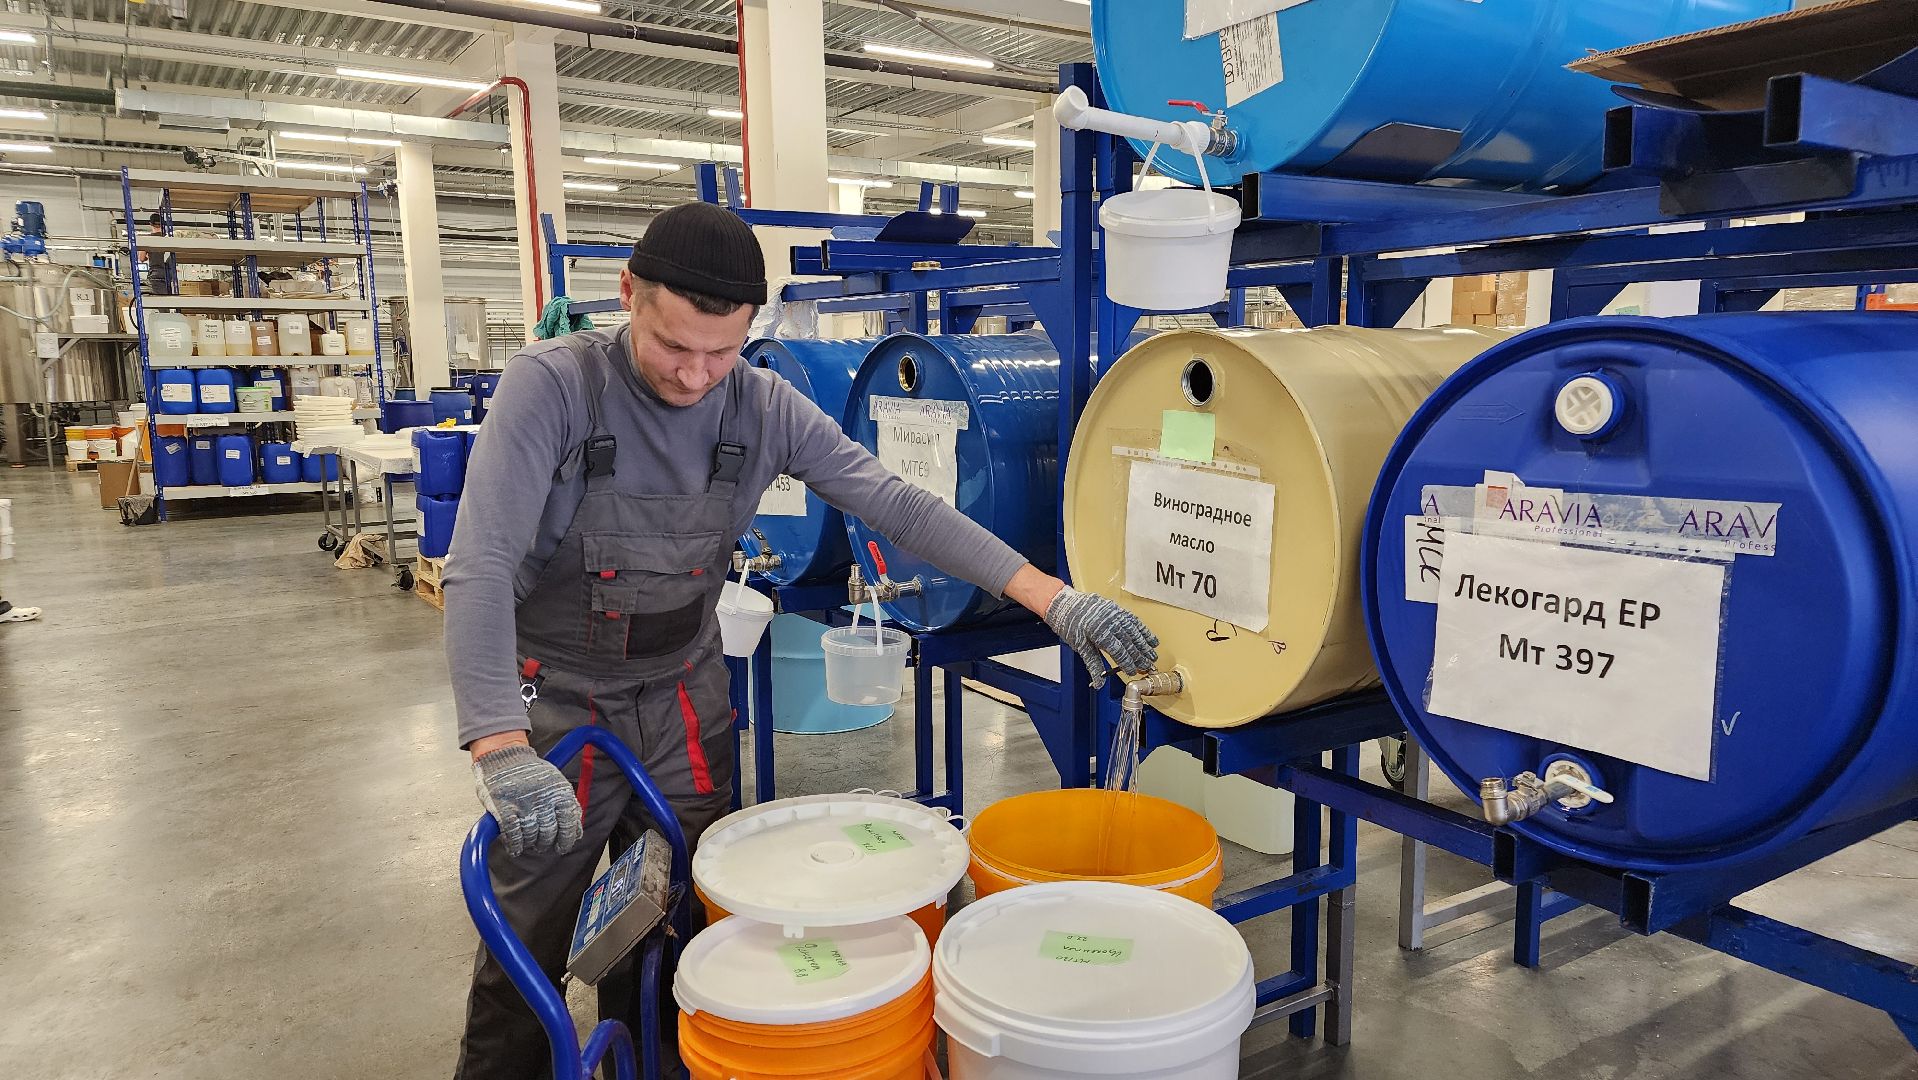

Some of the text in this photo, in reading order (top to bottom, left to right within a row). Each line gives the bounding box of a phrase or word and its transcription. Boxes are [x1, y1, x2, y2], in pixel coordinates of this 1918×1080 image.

[775, 476, 791, 492] 453
[1153, 491, 1252, 527] Виноградное
[1498, 495, 1603, 528] ARAVIA
[1677, 505, 1776, 539] ARAV
[1169, 532, 1215, 553] масло
[1534, 525, 1603, 538] Professional
[1156, 560, 1217, 599] Мт 70
[1454, 573, 1606, 629] Лекогард
[1499, 633, 1615, 679] Мт 397
